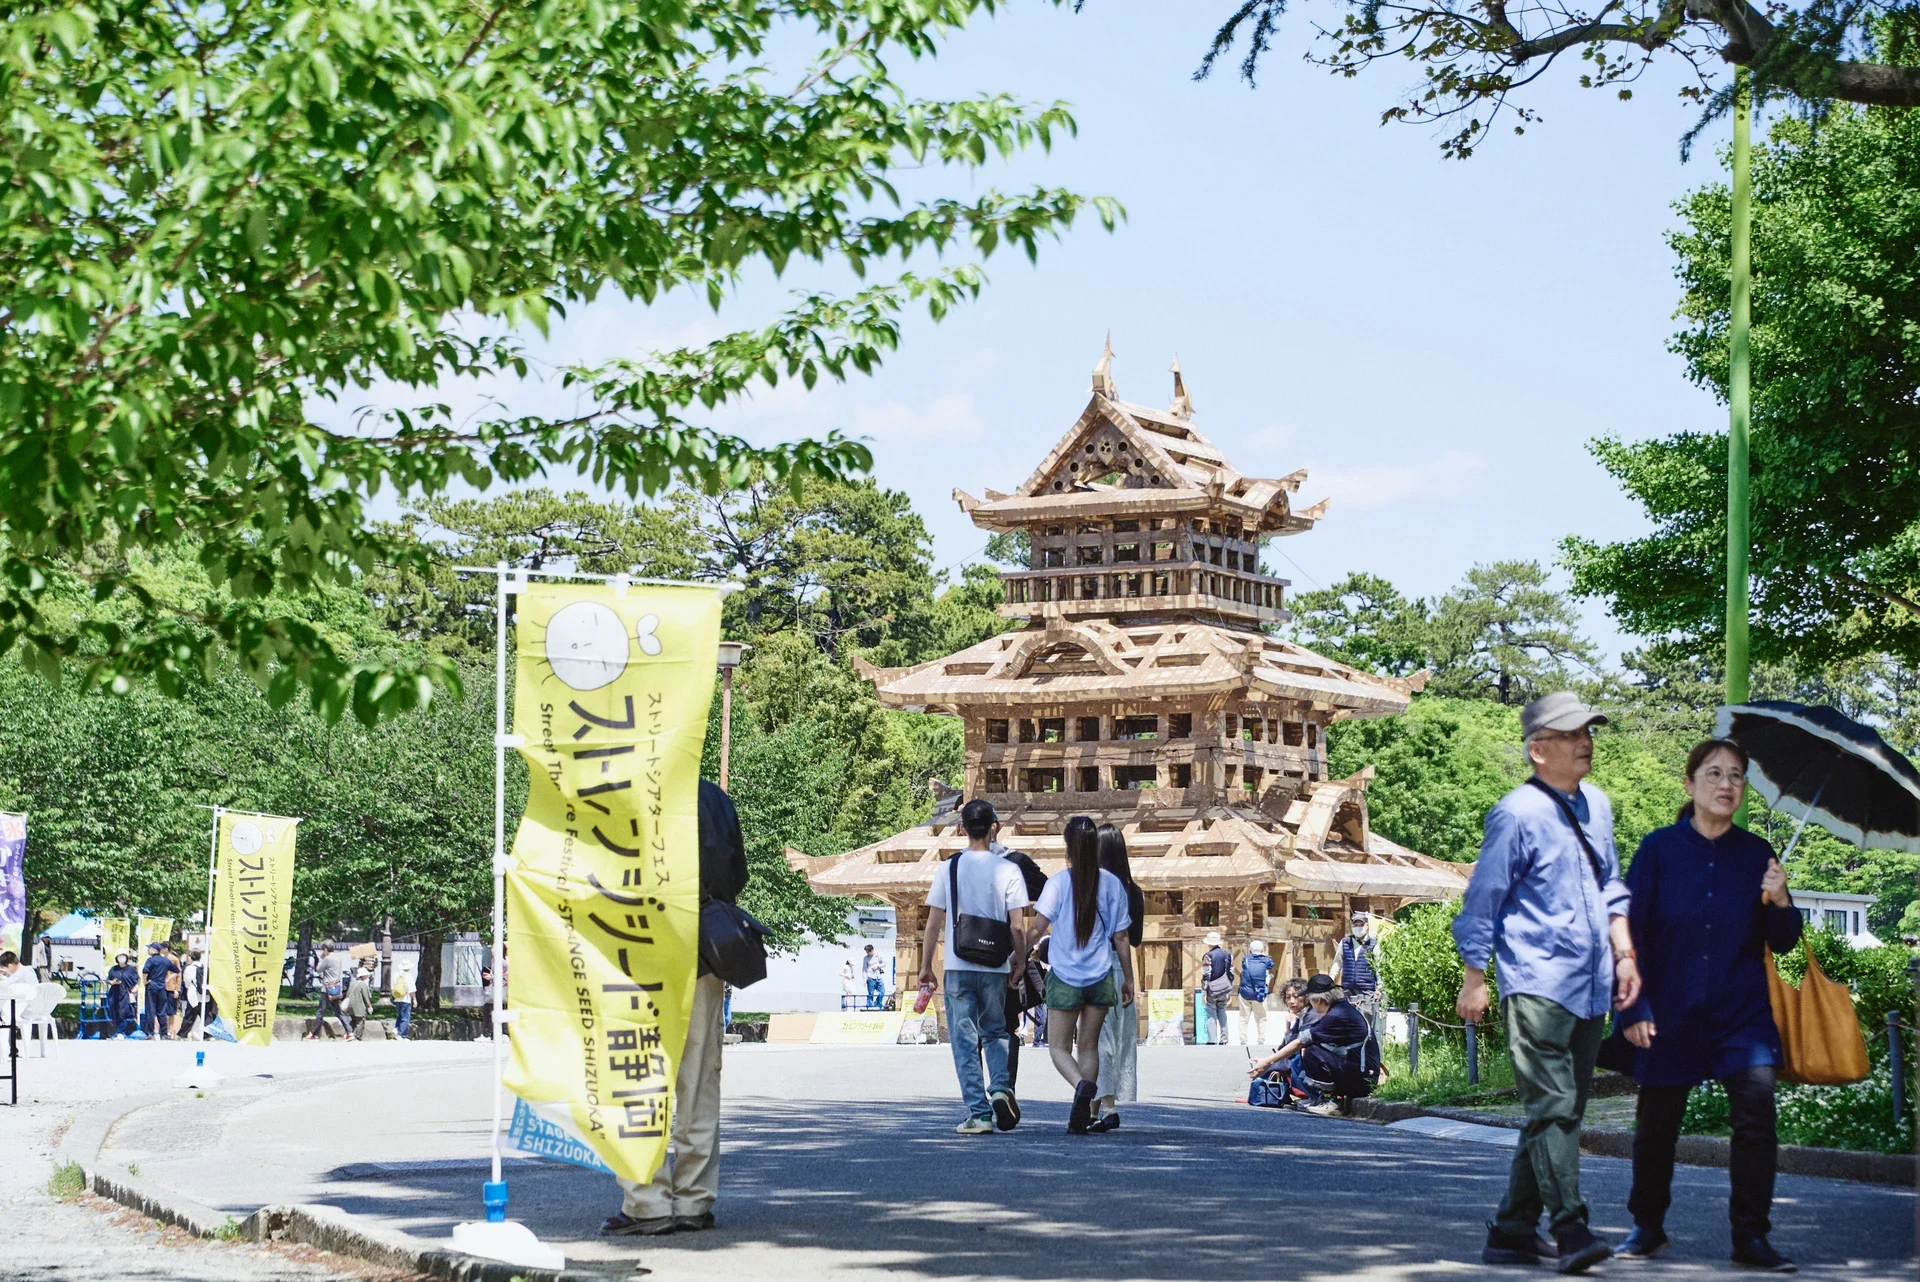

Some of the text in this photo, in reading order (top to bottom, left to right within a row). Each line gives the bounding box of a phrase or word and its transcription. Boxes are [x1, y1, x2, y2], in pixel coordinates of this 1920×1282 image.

[540, 703, 558, 755] Street
[548, 761, 576, 822] Thre
[647, 692, 670, 886] ストリートシアターフェス
[556, 828, 579, 892] Festival
[239, 858, 275, 1030] ストレンジシード静岡
[569, 695, 669, 1139] ストレンジシード静岡
[576, 987, 594, 1030] SEED
[523, 1135, 602, 1168] SHIZUOKA
